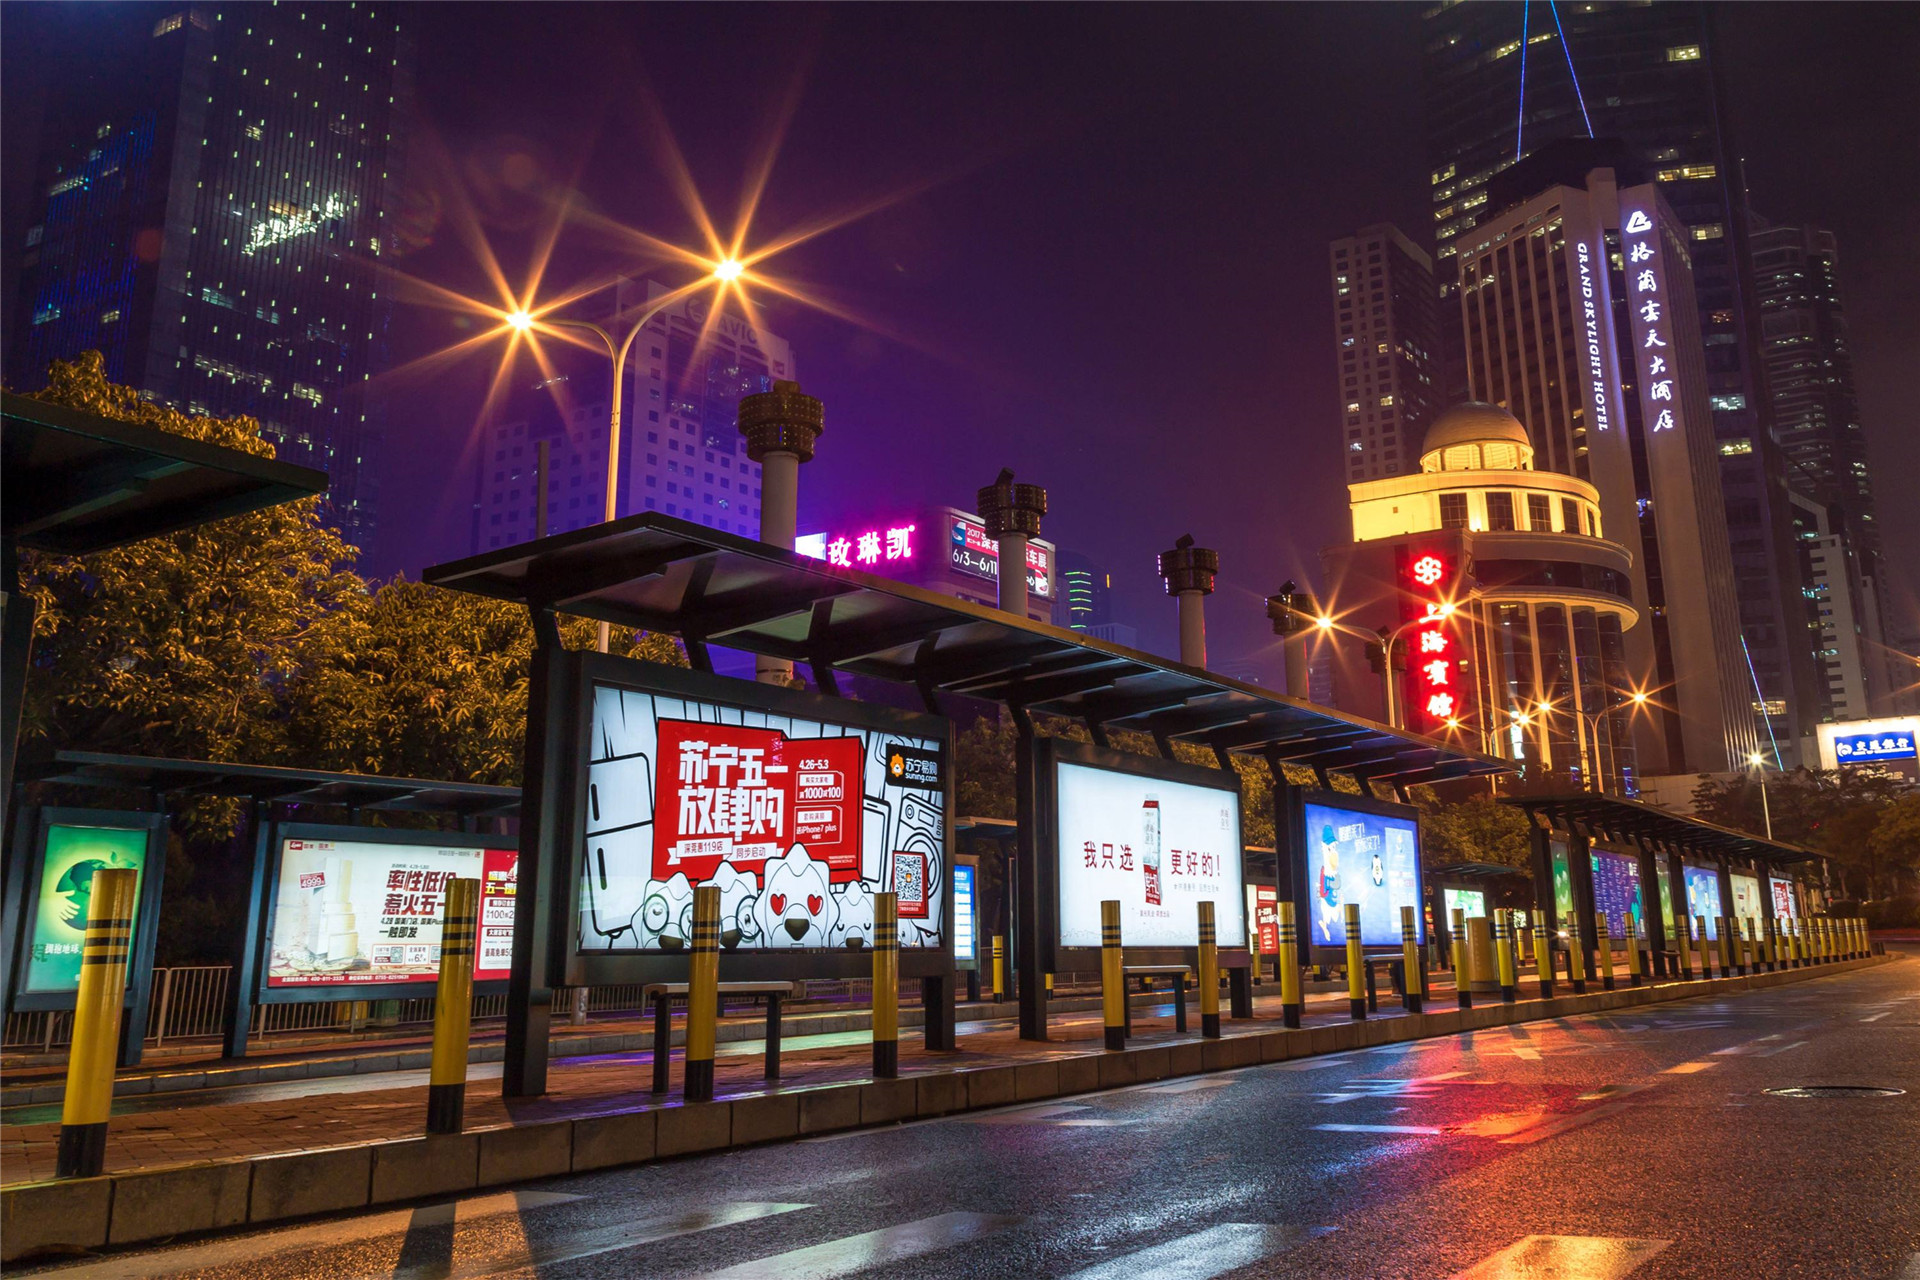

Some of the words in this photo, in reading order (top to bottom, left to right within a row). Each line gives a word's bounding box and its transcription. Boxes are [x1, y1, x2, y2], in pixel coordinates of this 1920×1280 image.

[1577, 242, 1593, 298] GRAND
[1584, 300, 1602, 378] SKYLIGHT
[1593, 381, 1608, 431] HOTEL
[679, 740, 789, 787] 苏宁五一
[799, 759, 829, 770] 4.26-5.3
[905, 757, 937, 775] 苏宁易购
[905, 772, 937, 783] suning.com
[678, 785, 784, 842] 放肆购
[736, 847, 766, 859] 同步启动
[1083, 840, 1133, 871] 我只选
[1171, 849, 1221, 877] 更好的!
[379, 926, 418, 938] 一触即发
